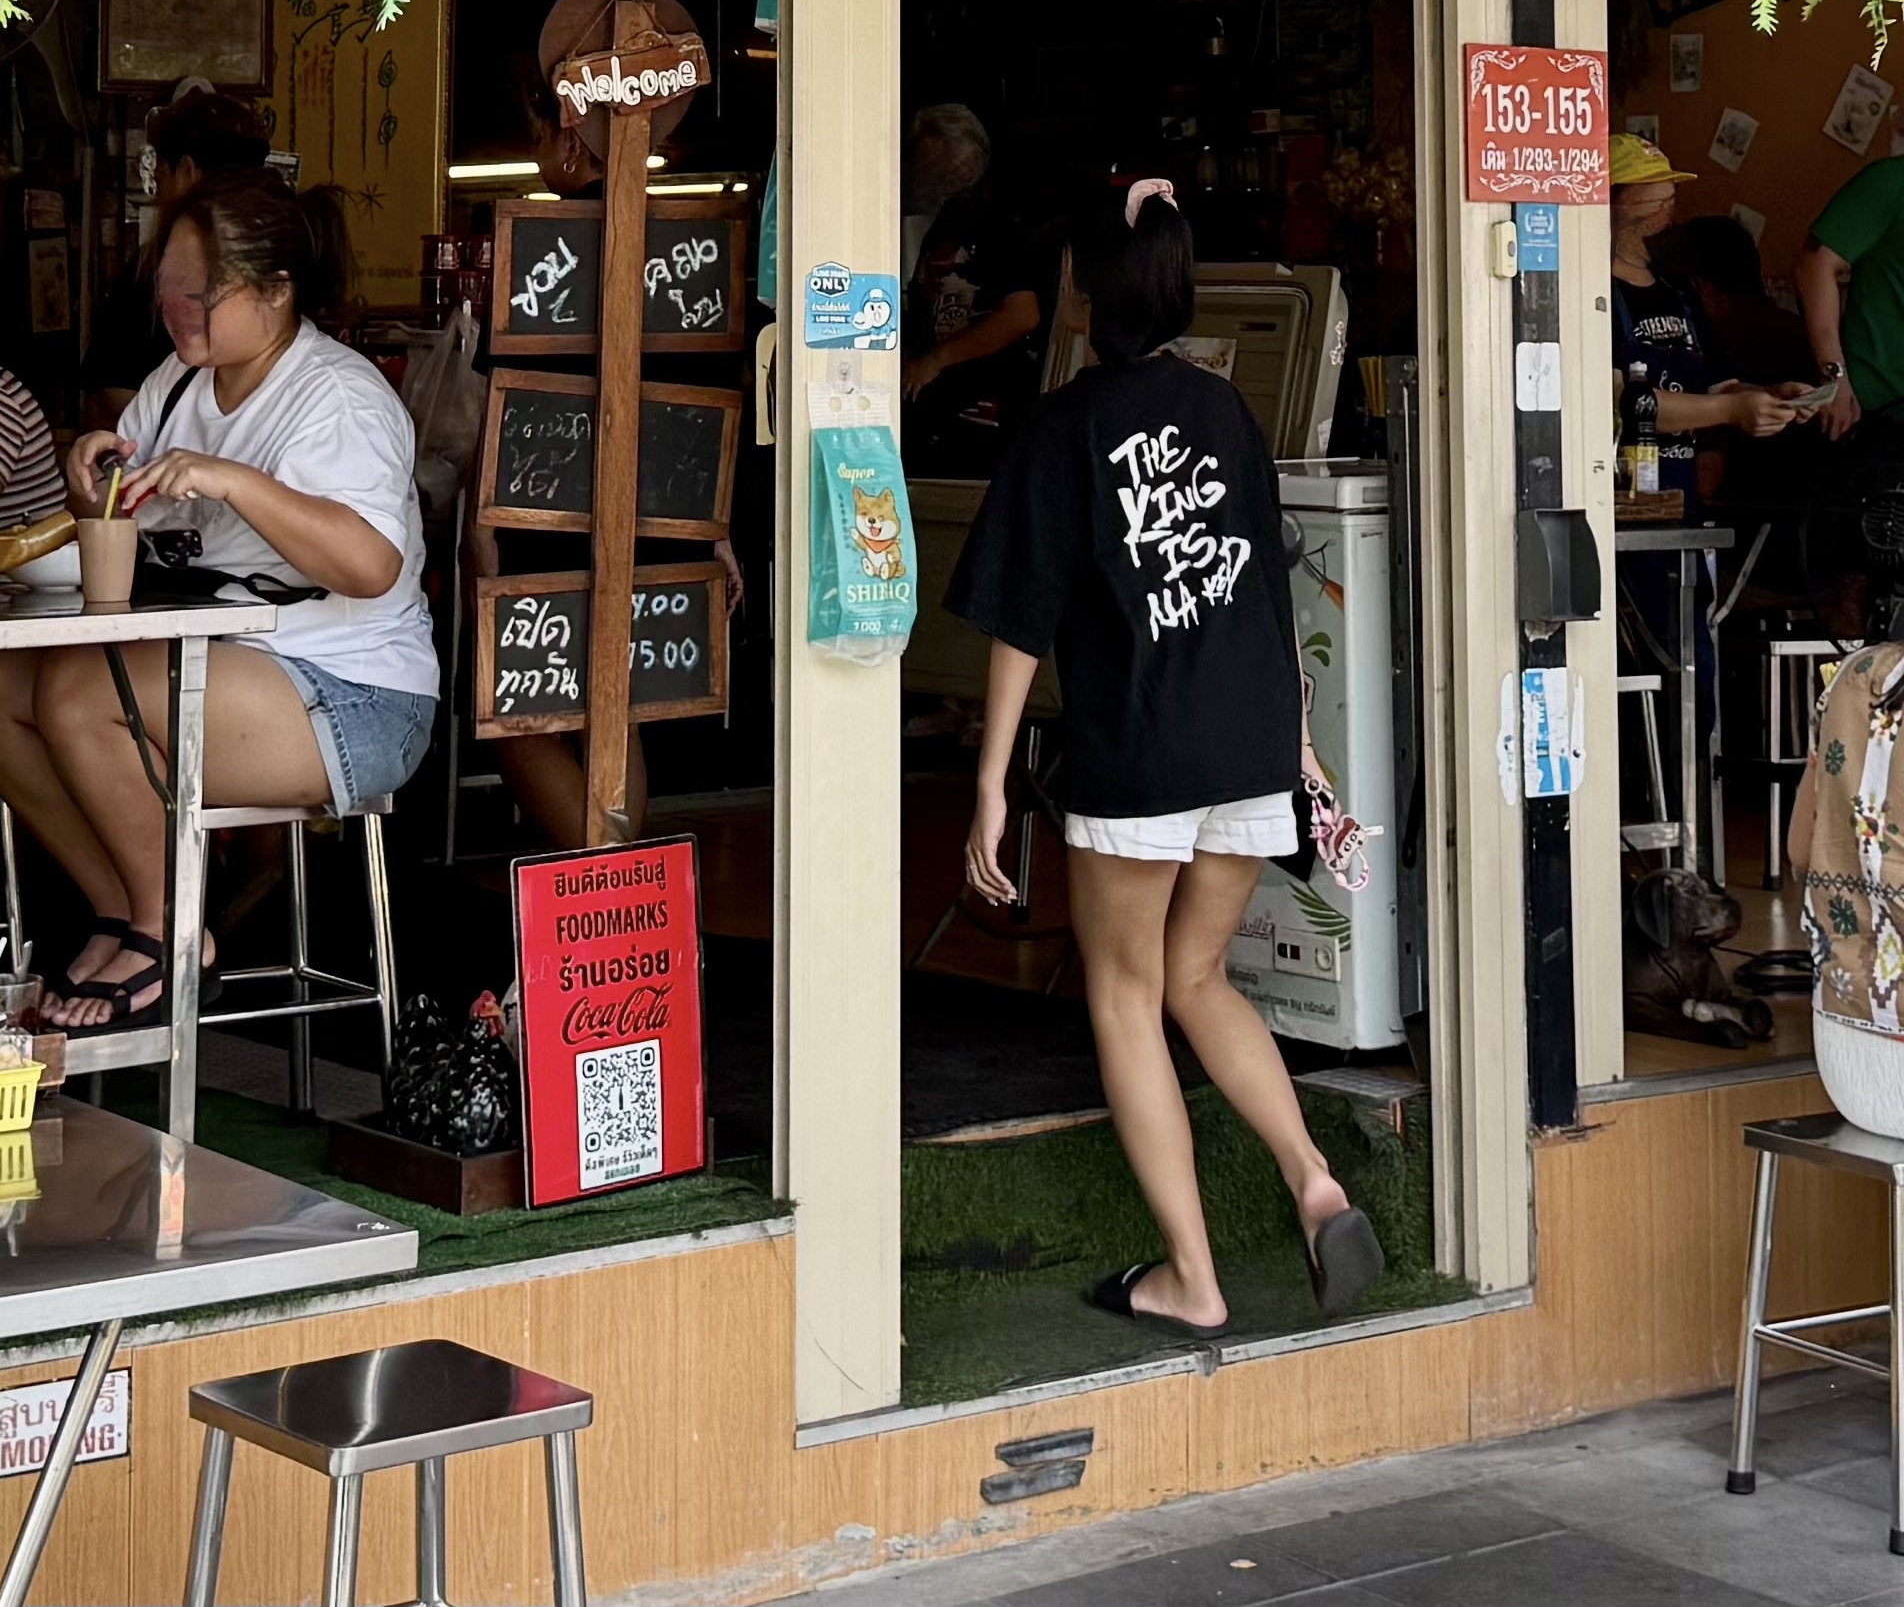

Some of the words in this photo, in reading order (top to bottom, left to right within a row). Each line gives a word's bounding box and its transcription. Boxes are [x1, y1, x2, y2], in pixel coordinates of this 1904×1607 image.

[557, 56, 697, 116] Welcome
[1482, 84, 1592, 136] 153-155
[1481, 141, 1506, 171] เดิม
[1513, 147, 1600, 172] 1/293-1/294
[811, 277, 851, 291] ONLY
[1108, 424, 1191, 486] THE
[1117, 456, 1227, 568] KING
[1158, 522, 1218, 582] IS
[500, 597, 571, 649] เปิด
[496, 651, 579, 713] ทุกวัน
[553, 854, 667, 899] ยินดีต้อนรับสู่
[556, 900, 669, 946] FOODMARKS
[559, 944, 671, 993] ร้านอร่อย
